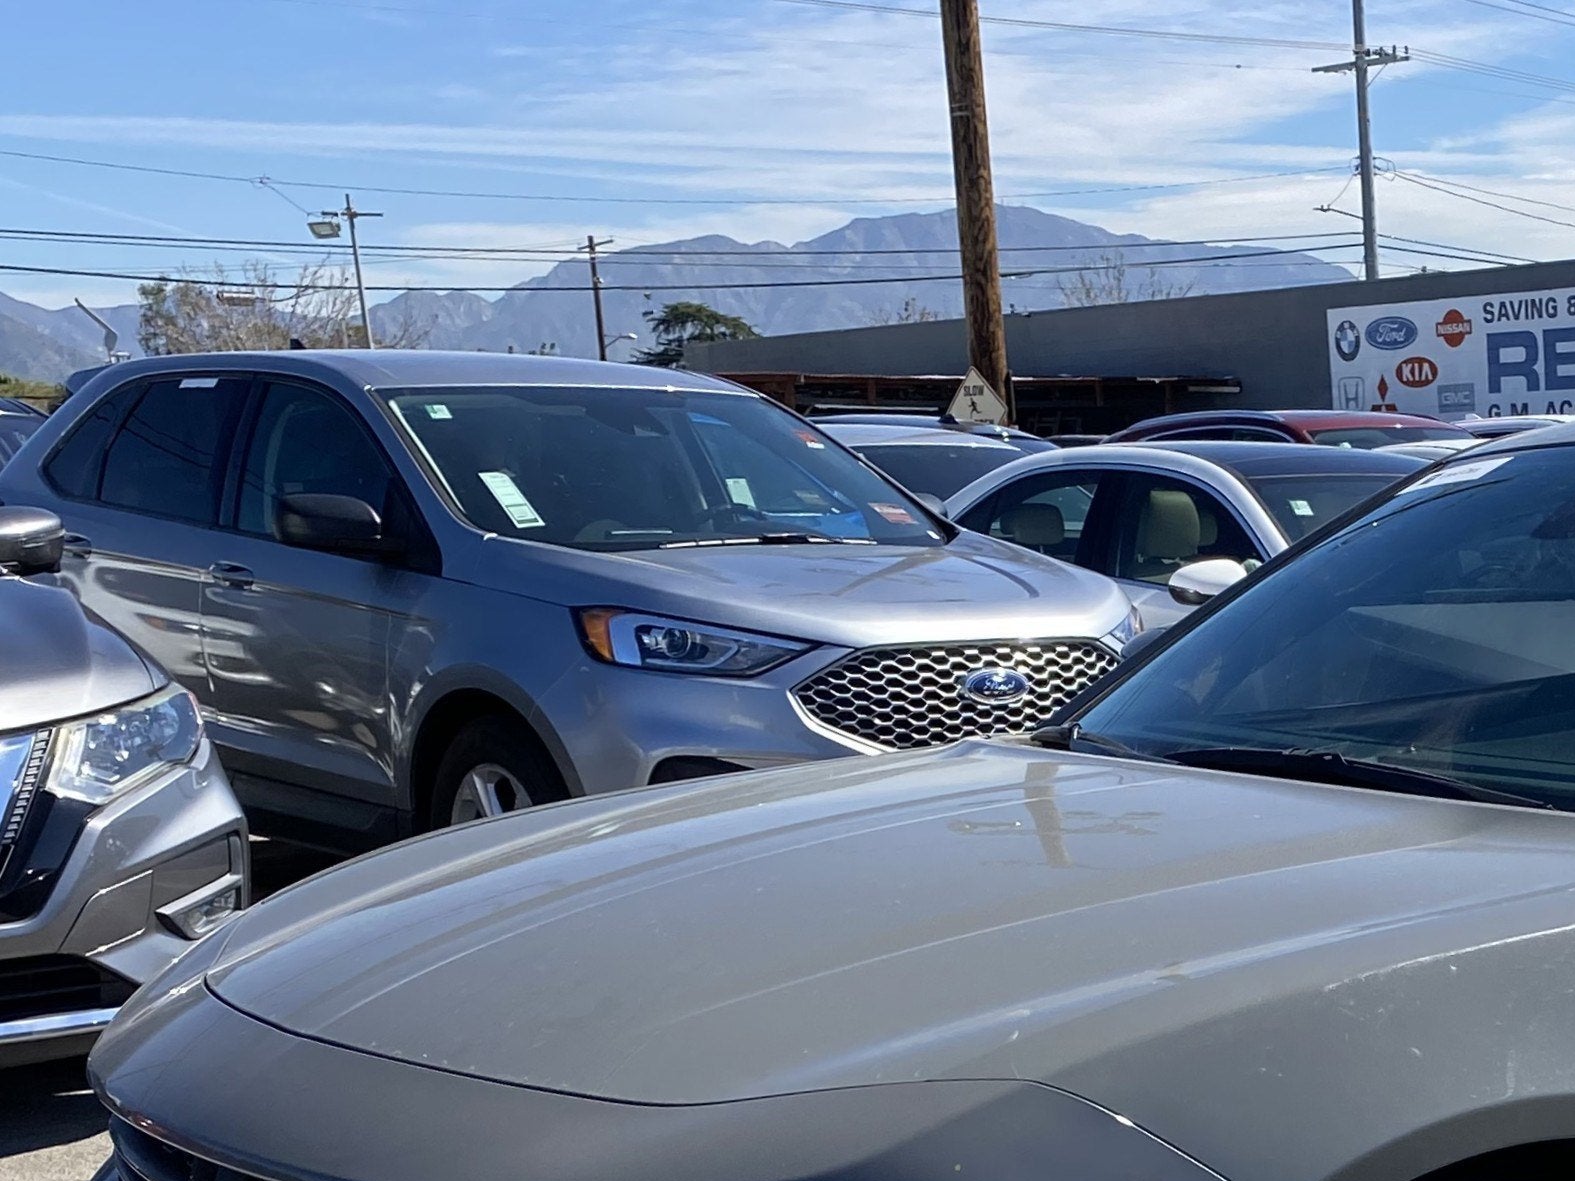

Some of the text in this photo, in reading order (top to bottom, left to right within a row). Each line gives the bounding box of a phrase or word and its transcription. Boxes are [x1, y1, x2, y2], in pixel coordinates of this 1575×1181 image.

[1482, 297, 1558, 323] SAVING
[1376, 322, 1406, 342] Ford
[1437, 321, 1471, 335] NISSAN
[1401, 362, 1433, 382] KIA
[963, 385, 984, 397] SLOW
